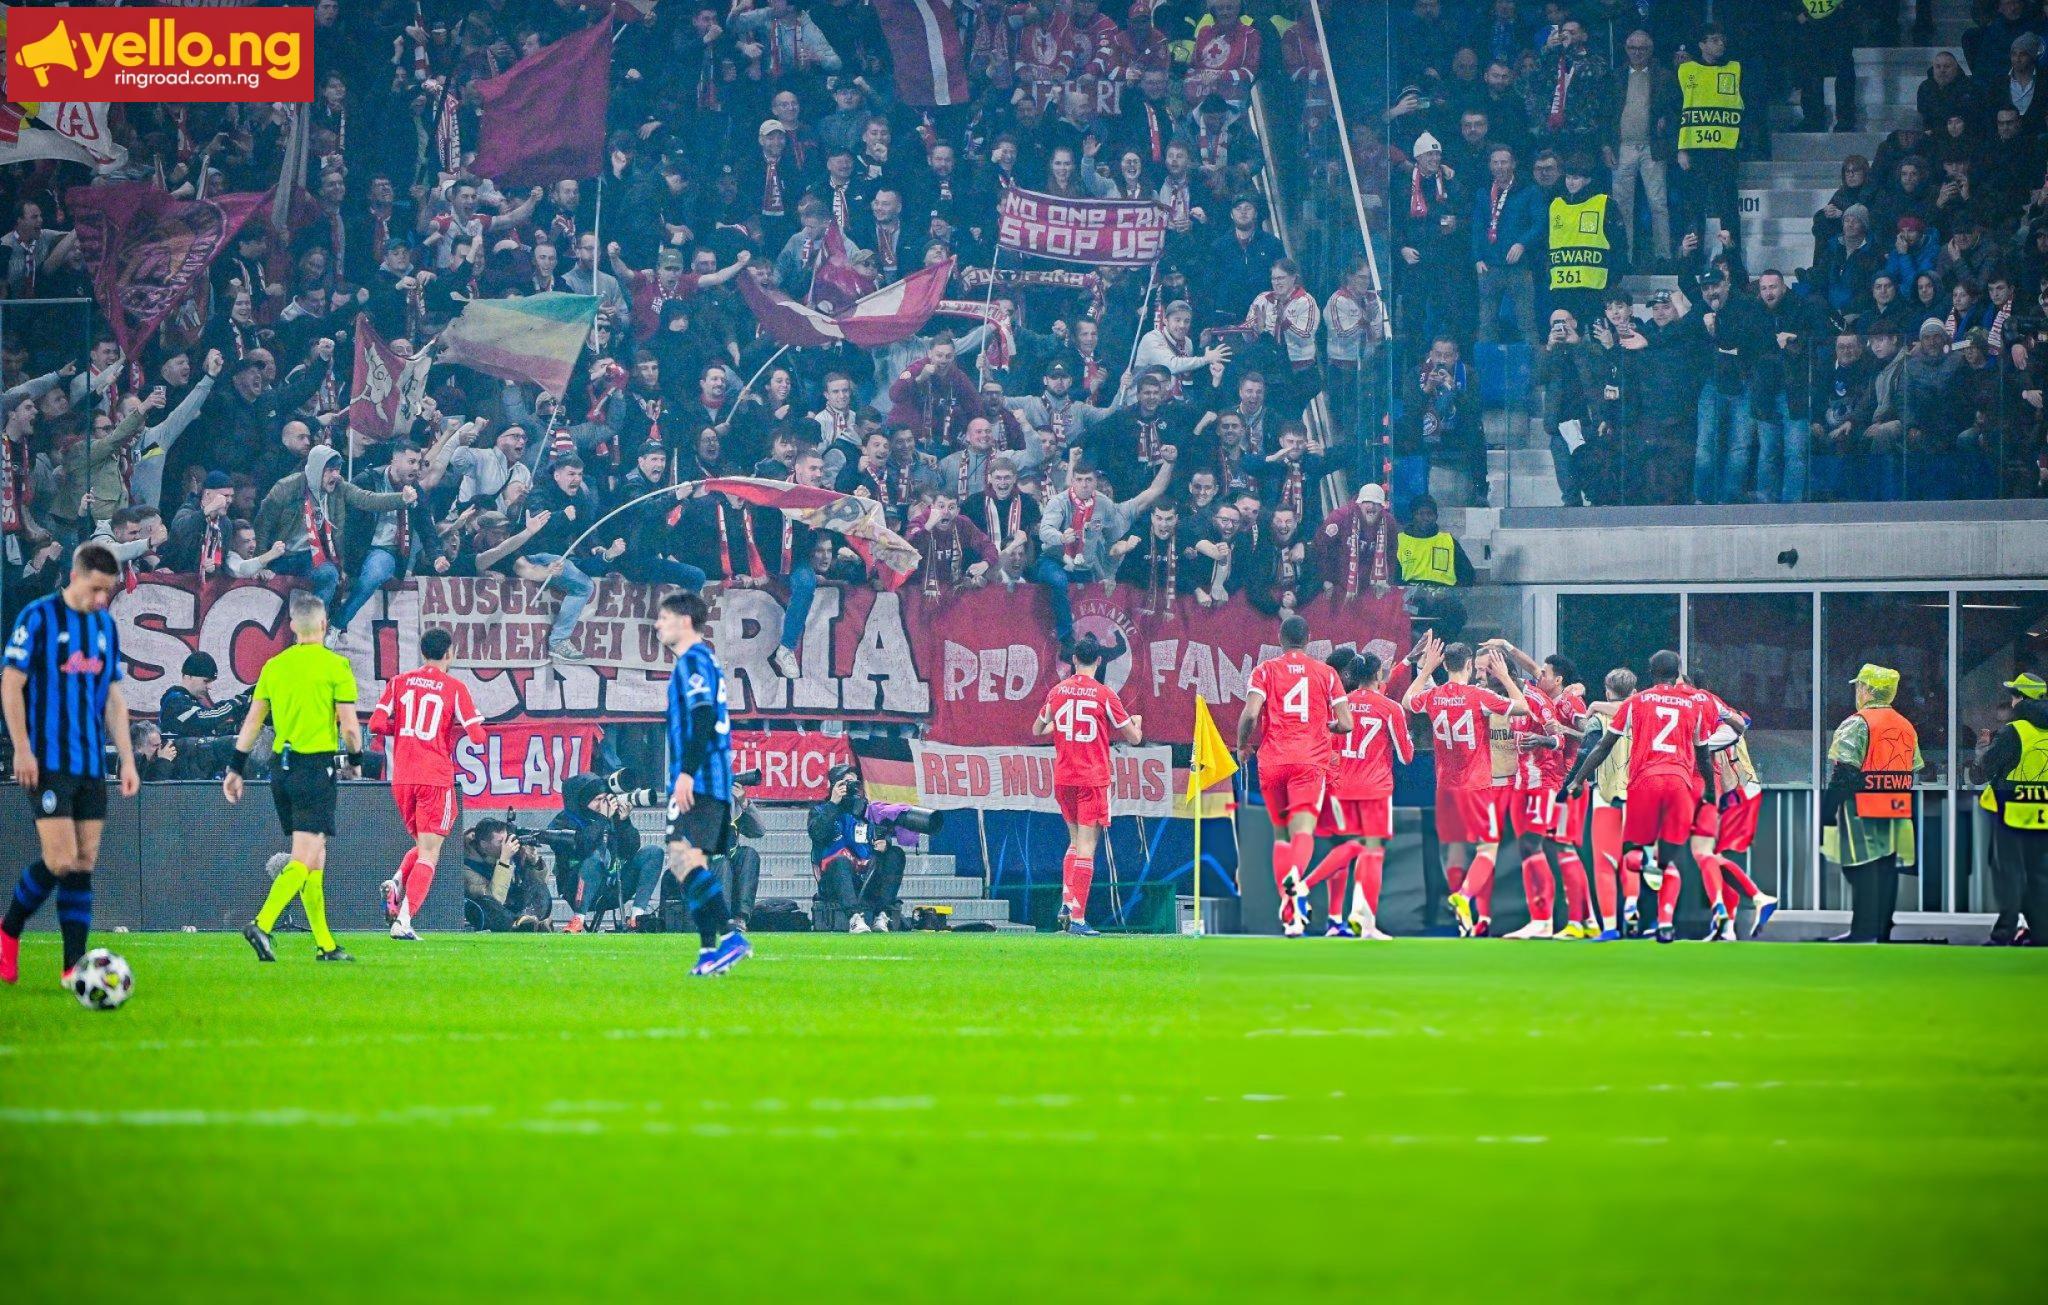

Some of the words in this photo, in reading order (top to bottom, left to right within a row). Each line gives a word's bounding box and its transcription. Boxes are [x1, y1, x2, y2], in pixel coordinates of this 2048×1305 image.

[1696, 130, 1722, 143] 340
[1006, 191, 1038, 221] NO
[1117, 206, 1168, 228] CAN
[1000, 216, 1099, 256] STOP
[1550, 249, 1603, 264] TEWARD
[1556, 270, 1581, 284] 361
[406, 677, 443, 691] MUSIALA
[944, 640, 1038, 702] RED
[1287, 664, 1306, 675] TAH
[400, 689, 444, 741] 10
[1283, 676, 1309, 723] 4
[1641, 694, 1693, 709] UPAMECANO
[1055, 698, 1098, 743] 45
[1341, 716, 1383, 759] 17
[1433, 709, 1476, 750] 44
[1652, 706, 1680, 753] 2
[921, 753, 990, 796] RED
